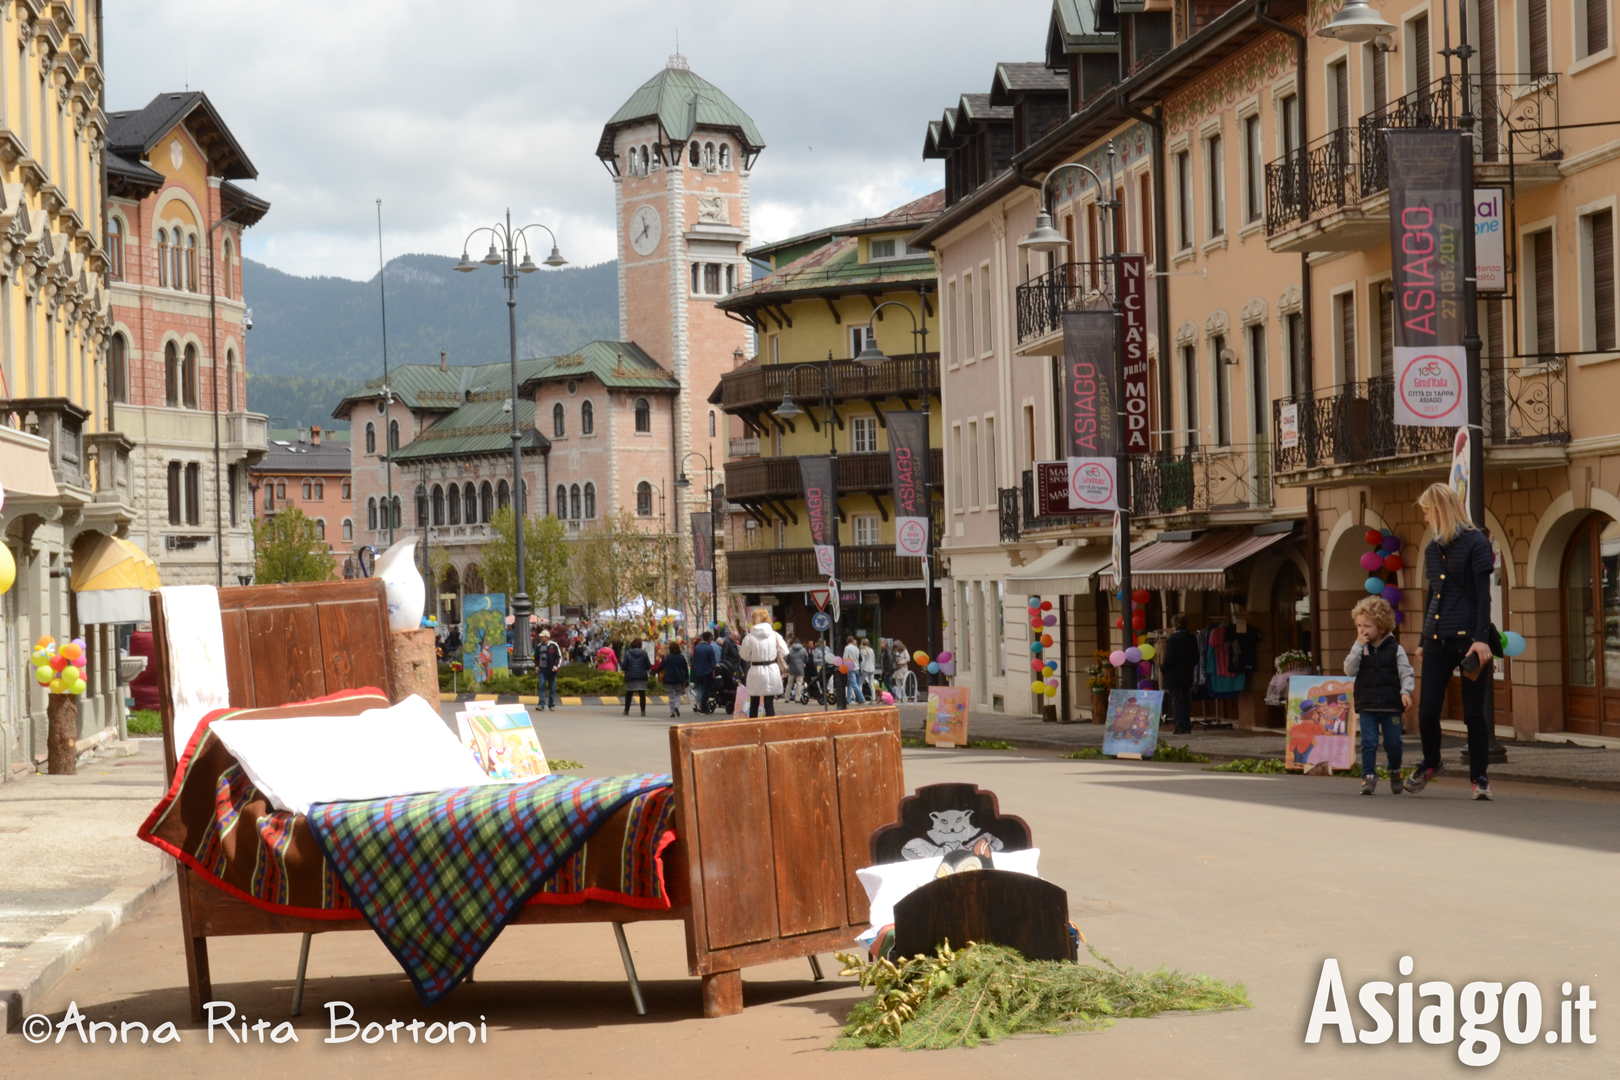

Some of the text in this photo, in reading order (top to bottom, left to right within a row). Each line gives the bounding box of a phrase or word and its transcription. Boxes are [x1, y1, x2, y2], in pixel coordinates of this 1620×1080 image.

[1401, 206, 1436, 336] ASIAGO
[1439, 222, 1457, 320] 27.05.2017
[1123, 360, 1148, 380] punto
[1414, 377, 1448, 388] Giro d'Italia
[1073, 362, 1098, 450] ASIAGO
[1099, 373, 1111, 440] 27.05.2017
[1125, 381, 1147, 447] MODA
[895, 447, 915, 512] ASIAGO
[1049, 488, 1069, 501] MAR
[807, 487, 824, 541] ASIAGO
